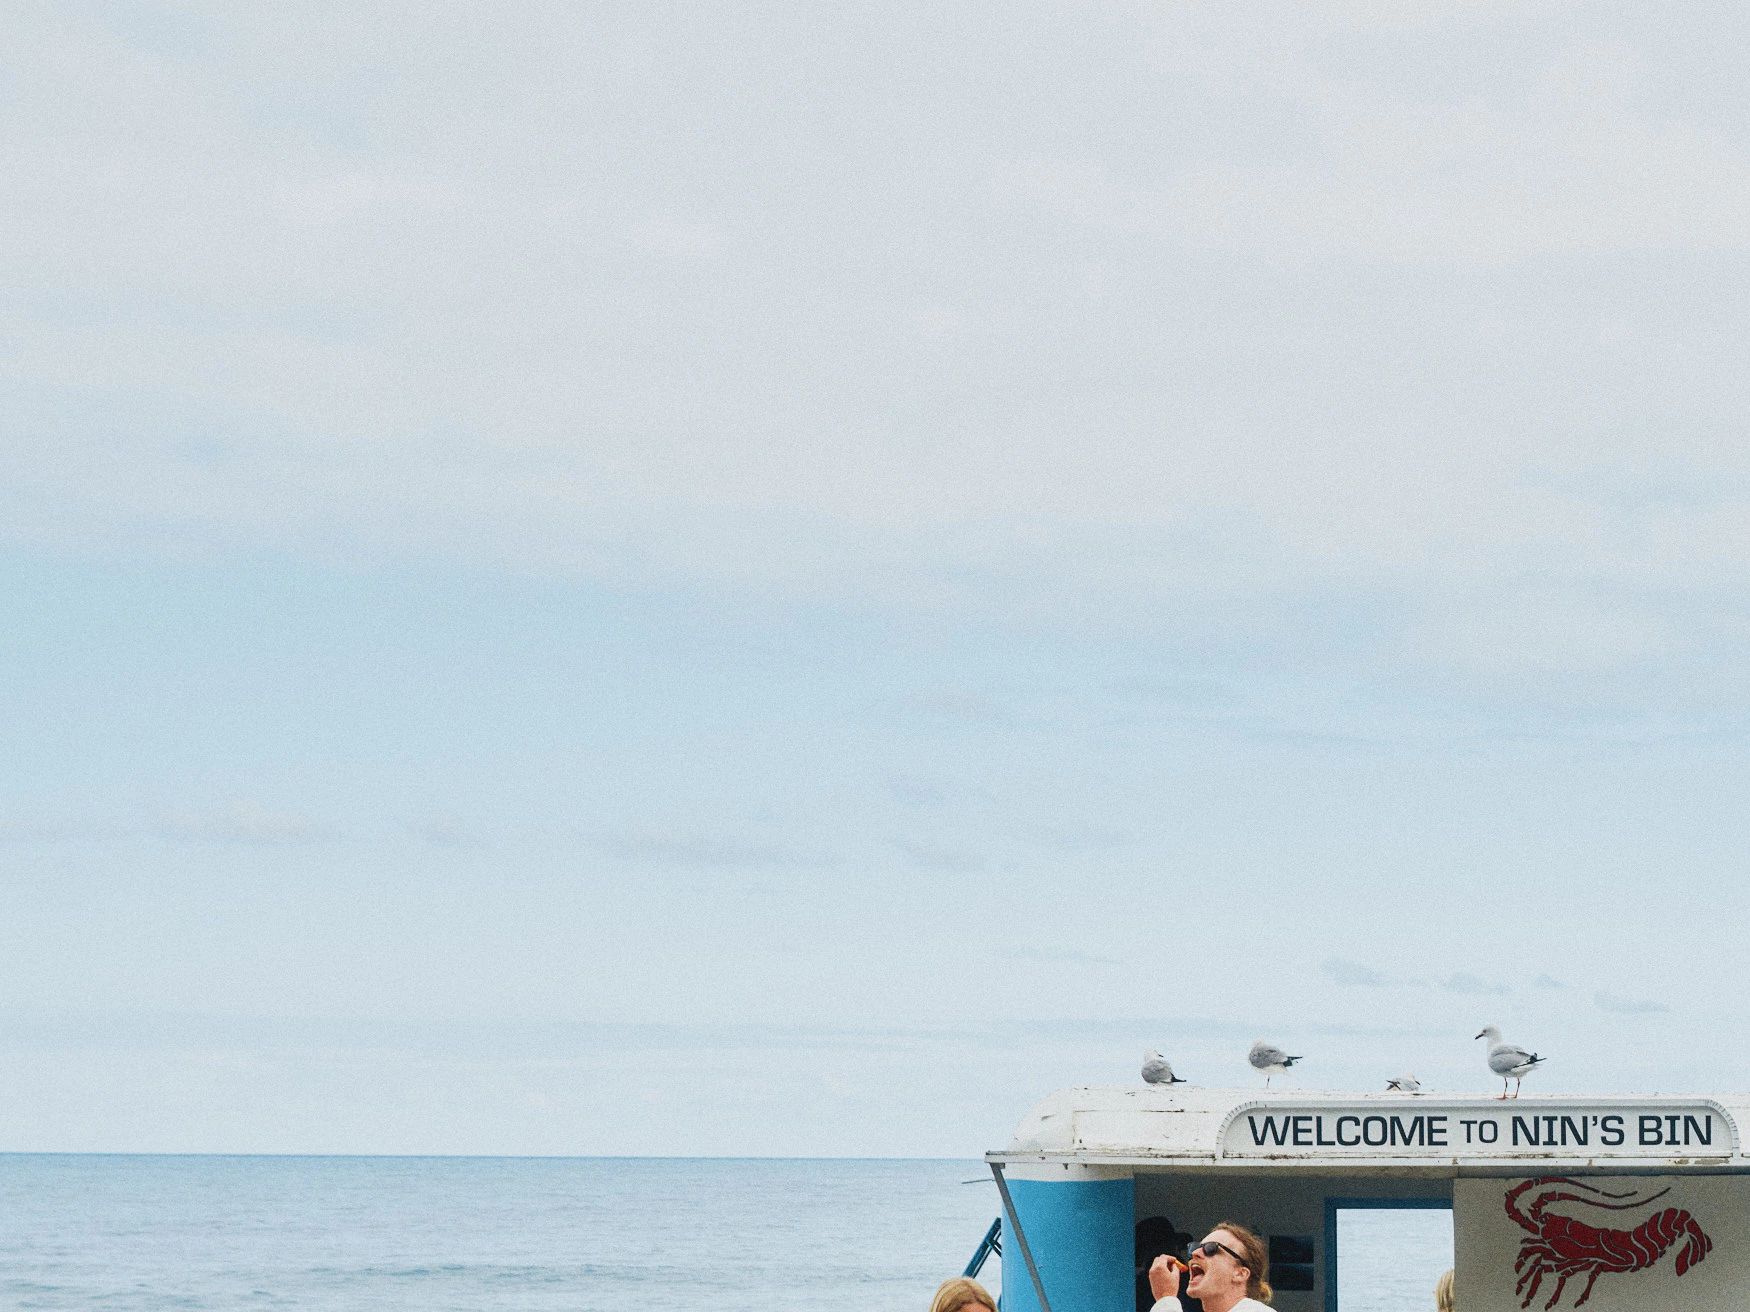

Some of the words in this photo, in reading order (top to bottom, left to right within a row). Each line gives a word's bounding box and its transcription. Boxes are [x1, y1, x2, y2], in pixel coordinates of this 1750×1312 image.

[1248, 1115, 1448, 1146] WELCOME
[1460, 1119, 1498, 1145] TO
[1512, 1115, 1625, 1147] NIN'S
[1638, 1115, 1712, 1146] BIN
